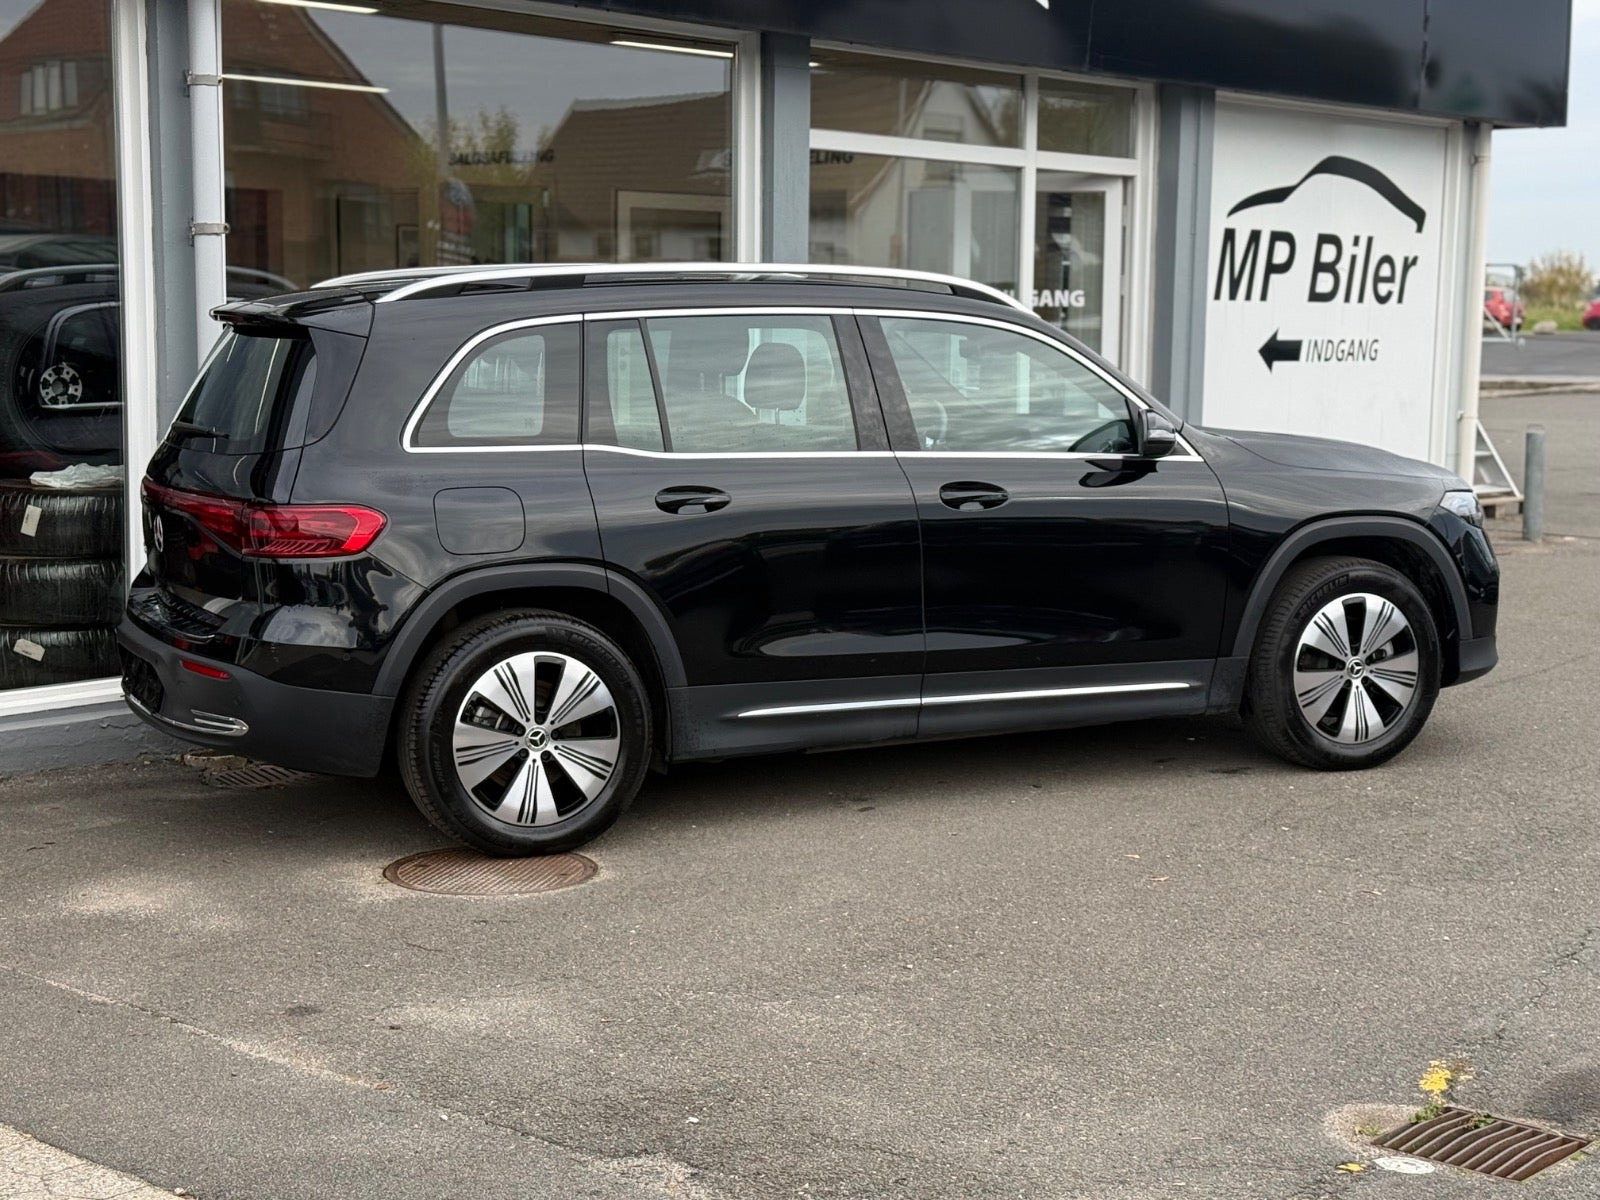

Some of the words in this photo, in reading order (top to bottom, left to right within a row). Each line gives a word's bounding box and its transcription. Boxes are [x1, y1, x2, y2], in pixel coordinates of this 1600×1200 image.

[1213, 227, 1297, 302] MP
[1307, 232, 1419, 305] Biler
[1305, 338, 1379, 363] INDGANG
